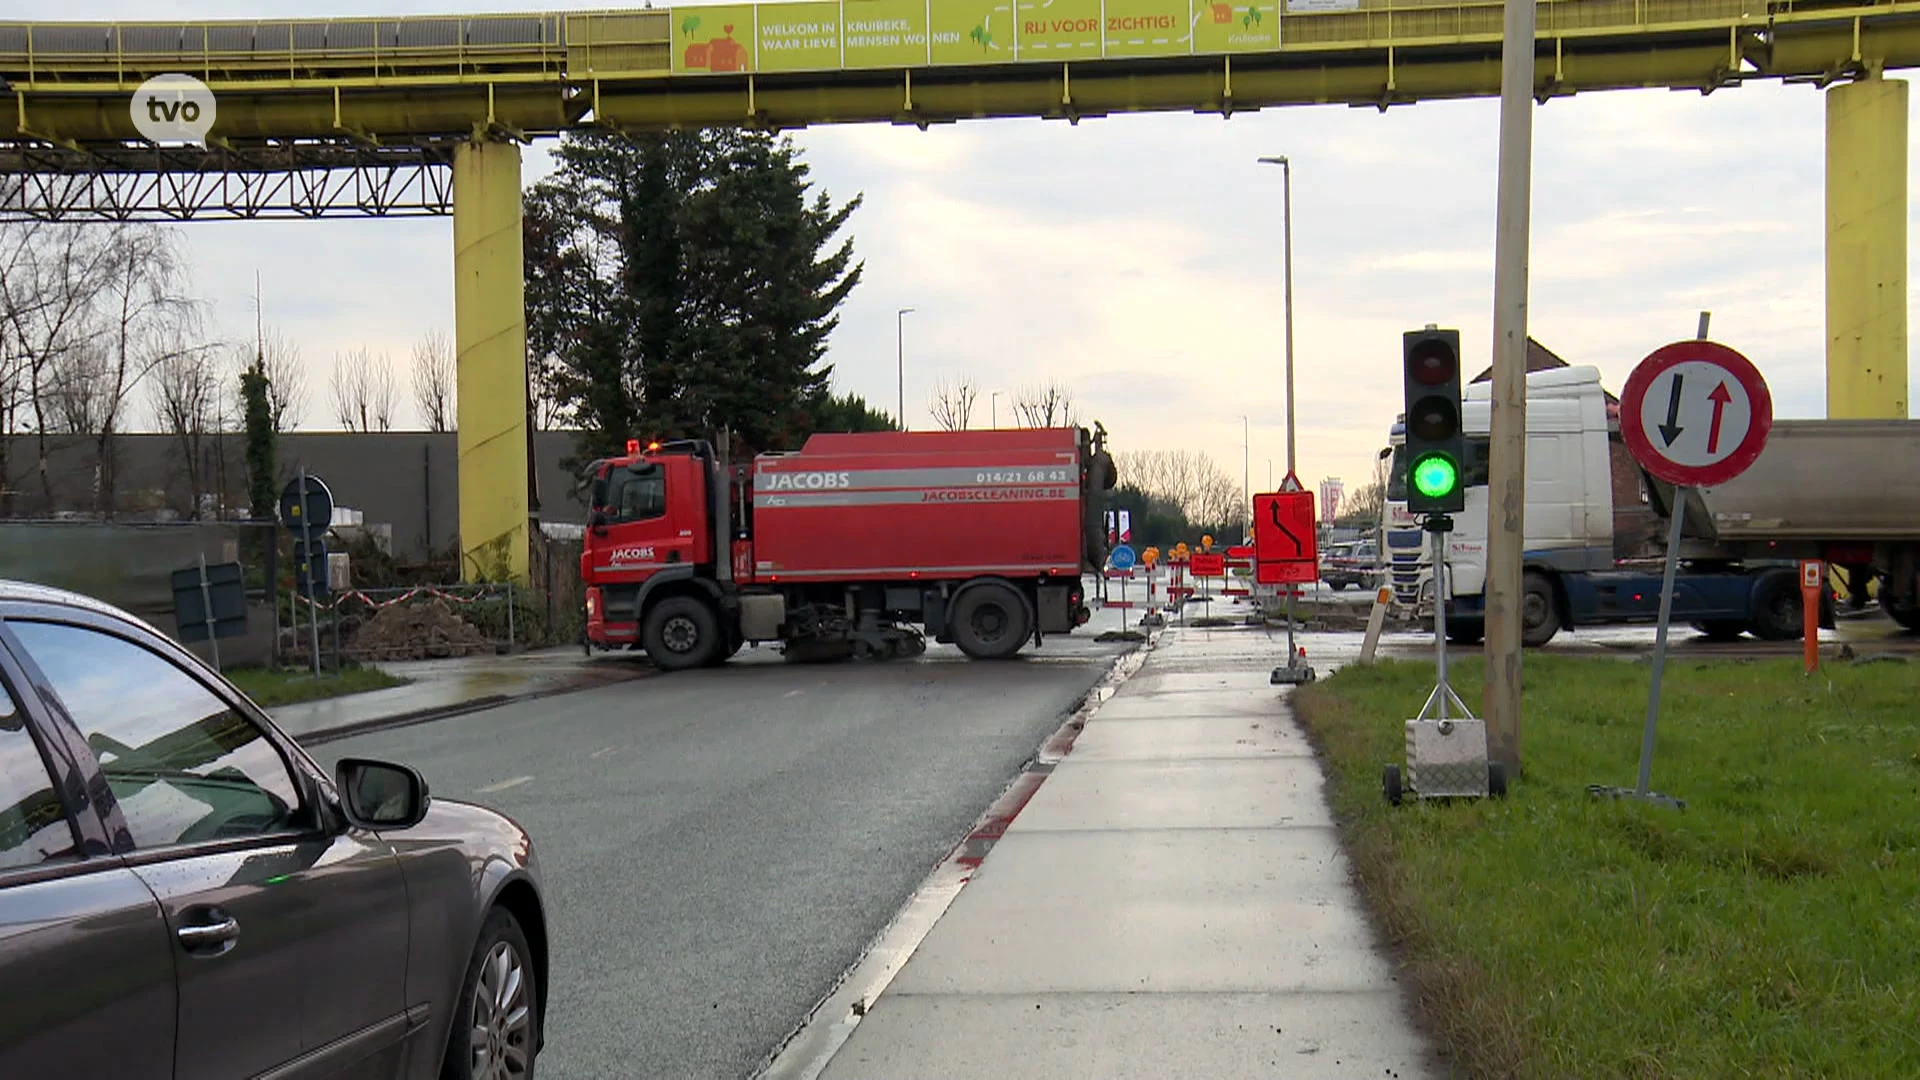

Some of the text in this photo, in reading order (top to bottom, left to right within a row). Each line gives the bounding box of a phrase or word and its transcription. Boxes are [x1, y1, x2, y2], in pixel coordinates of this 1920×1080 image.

[763, 23, 818, 36] WELKOM
[822, 21, 835, 33] IN
[1024, 20, 1047, 34] RIJ
[763, 39, 800, 51] WAAR
[803, 37, 837, 49] LIEVE
[847, 35, 900, 48] MENSEN
[766, 472, 849, 490] JACOBS
[976, 470, 1066, 483] 014/21 68 43
[921, 488, 1066, 502] JACOBSCLEANING.BE
[609, 547, 655, 561] JACOBS
